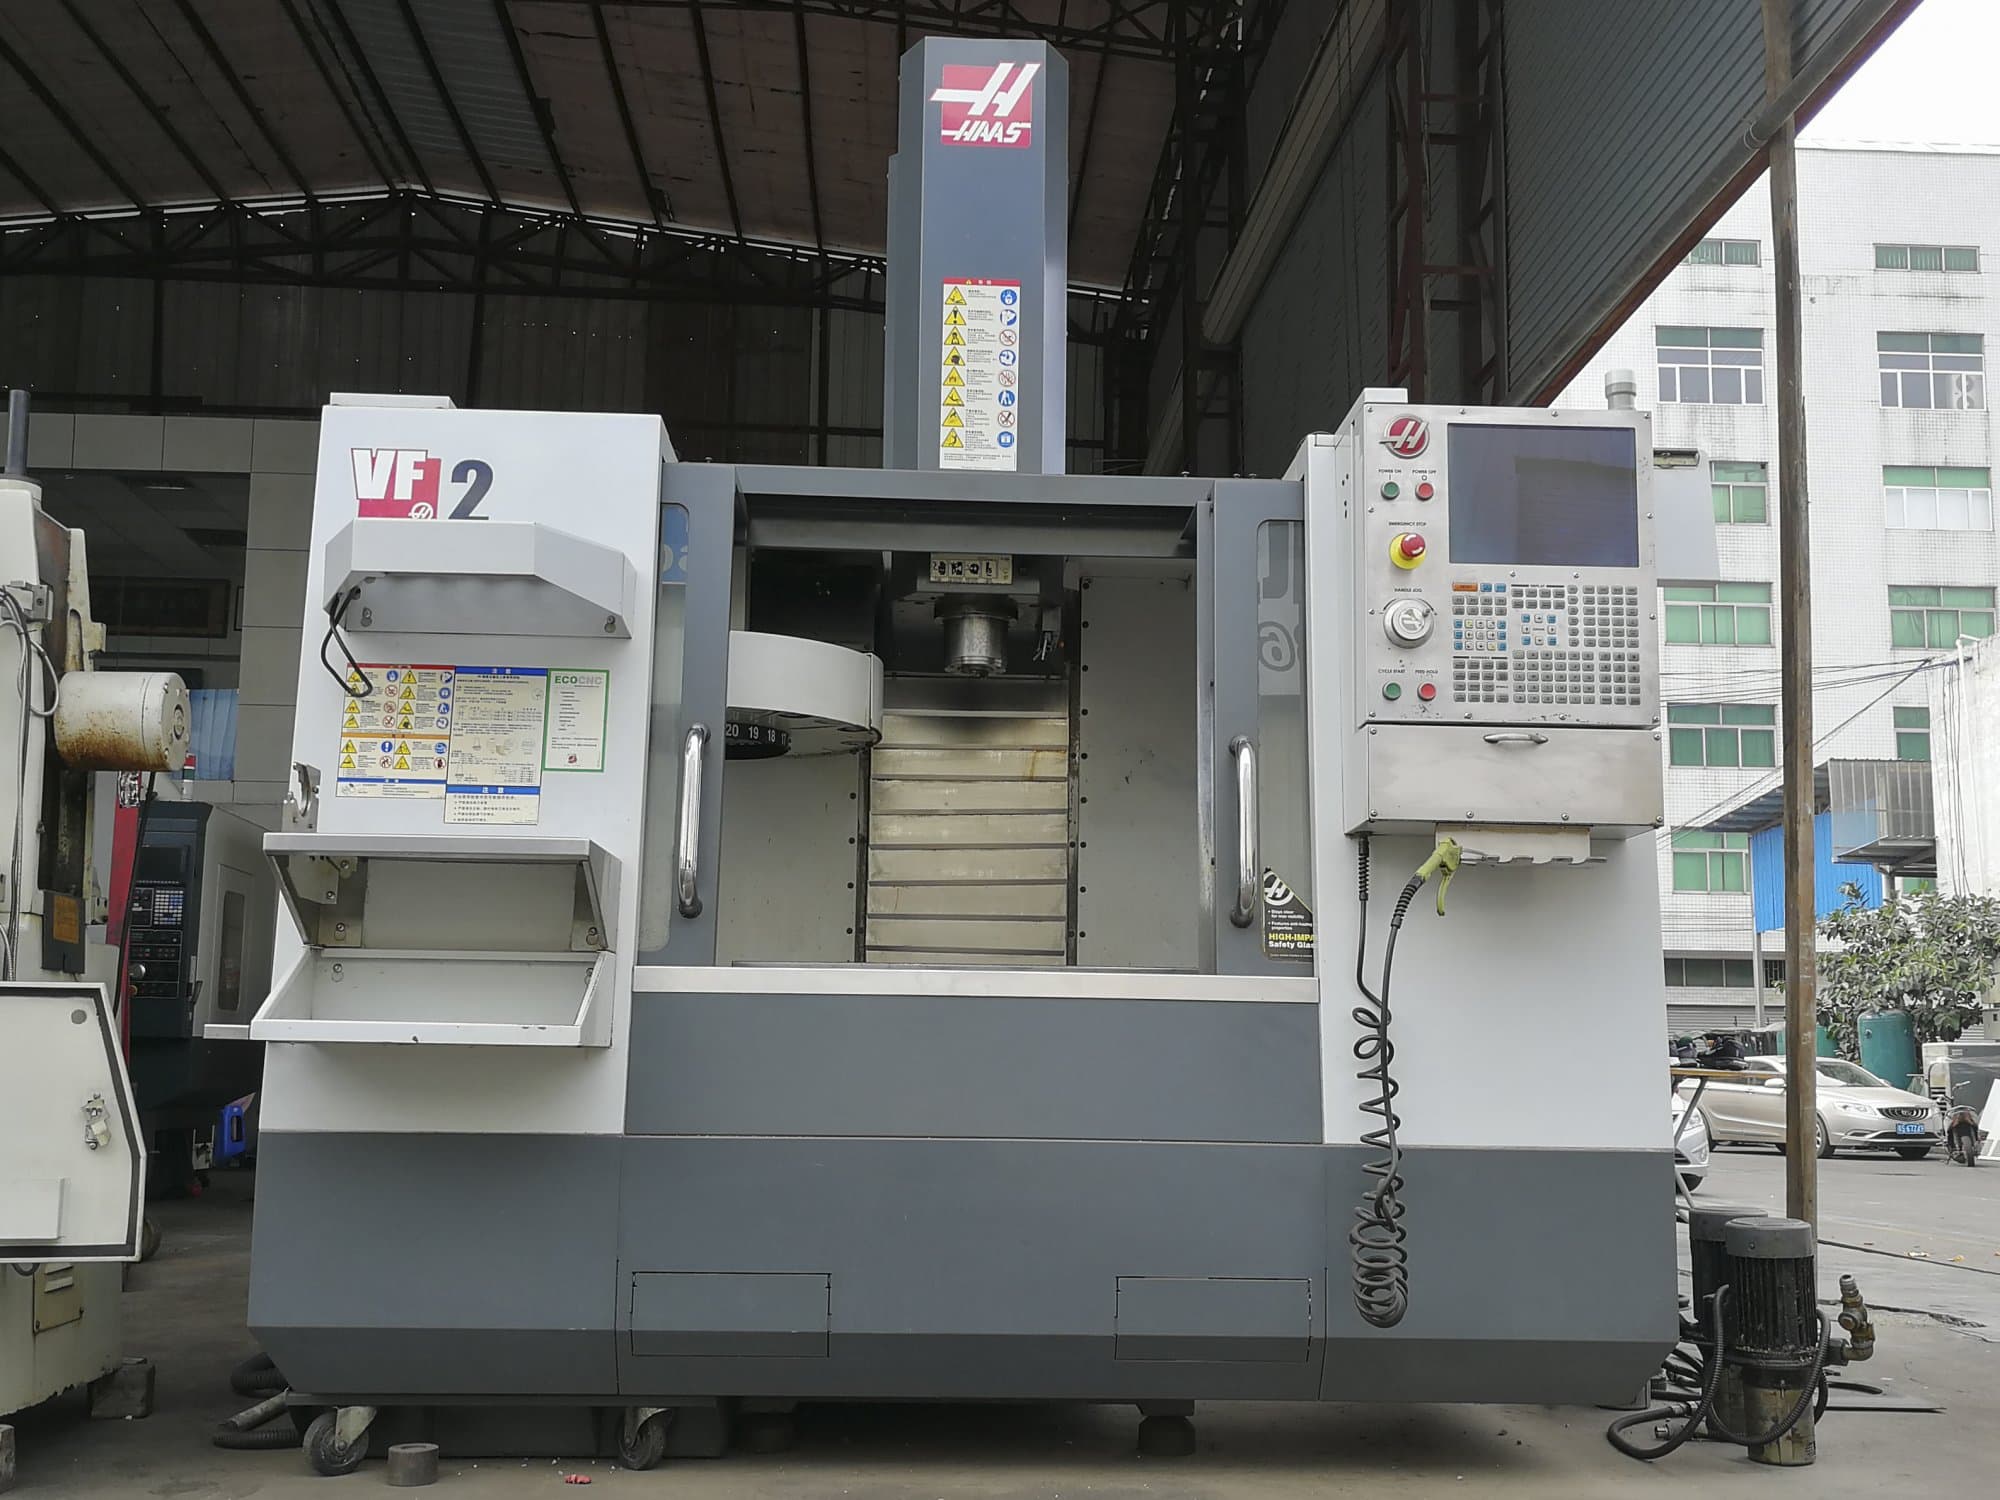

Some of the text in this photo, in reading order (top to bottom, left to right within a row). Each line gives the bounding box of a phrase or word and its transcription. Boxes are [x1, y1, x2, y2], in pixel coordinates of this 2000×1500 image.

[941, 120, 1032, 143] HAAS
[351, 447, 494, 520] VF 2
[554, 675, 602, 685] ECOCNC
[726, 723, 739, 737] 20
[748, 726, 759, 740] 19
[767, 728, 776, 743] 18
[1268, 940, 1295, 949] Safety
